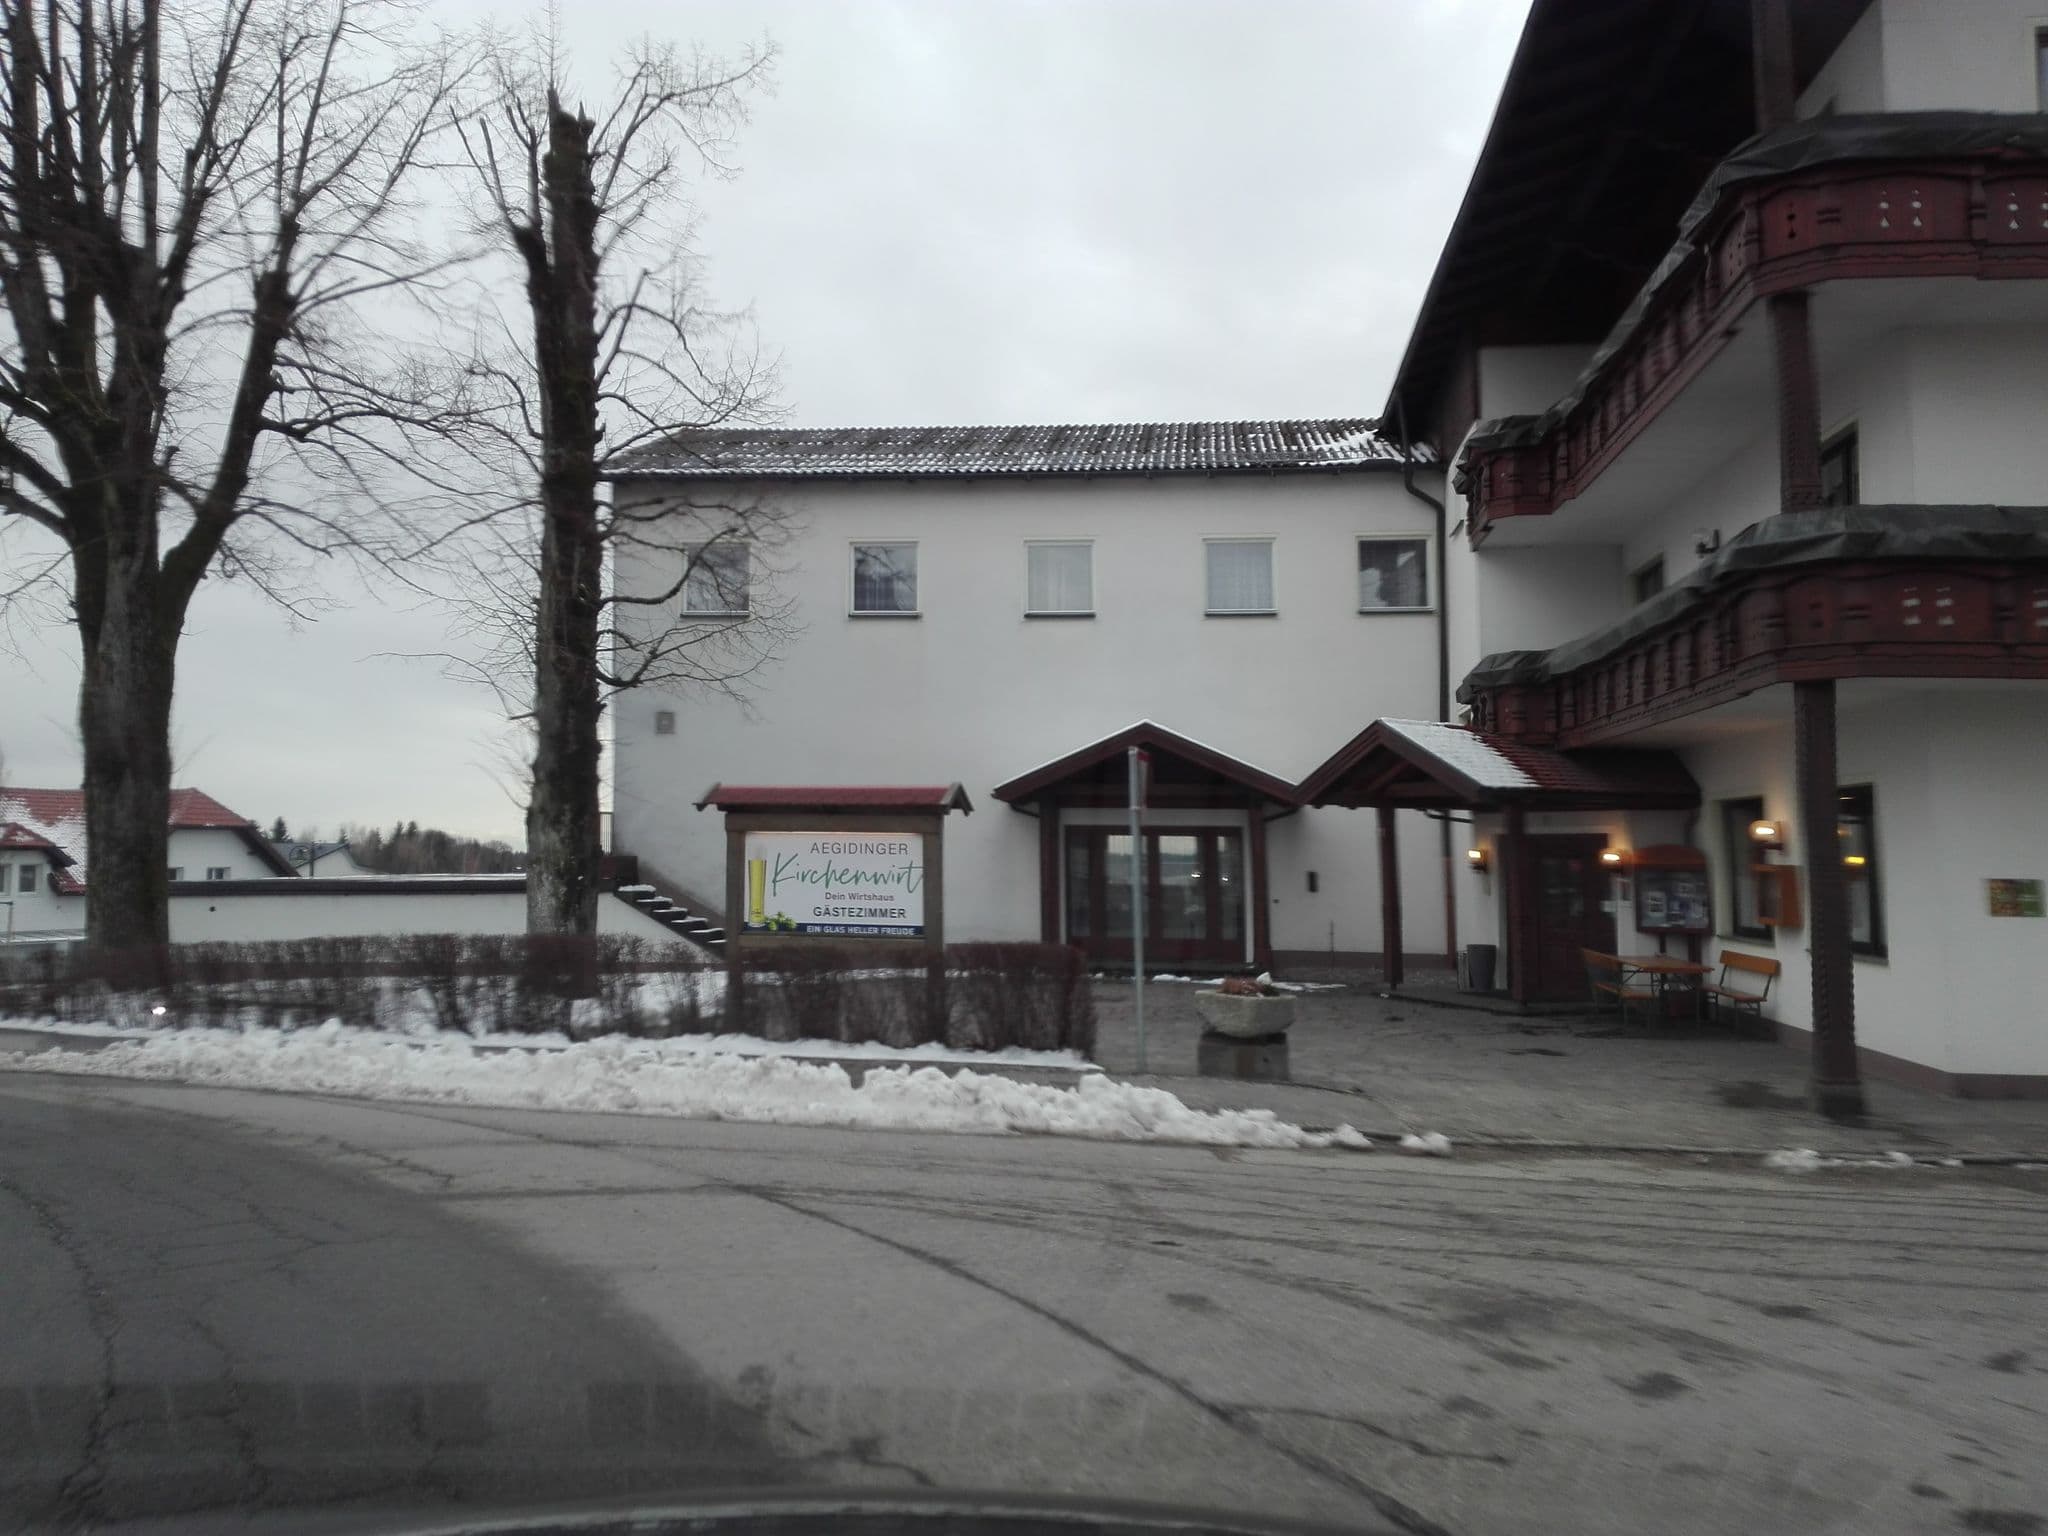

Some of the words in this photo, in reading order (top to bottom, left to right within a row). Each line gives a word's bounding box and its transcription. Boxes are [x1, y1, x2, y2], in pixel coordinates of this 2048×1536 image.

[810, 842, 909, 855] AEGIDINGER
[772, 852, 925, 897] Kirchenwirt
[825, 892, 846, 901] Dein
[848, 892, 895, 901] Wirtshaus
[813, 906, 906, 919] GÄSTEZIMMER
[806, 925, 821, 934] EIN
[823, 925, 845, 934] GLAS
[847, 926, 878, 935] HELLER
[881, 926, 915, 936] FREUDE
